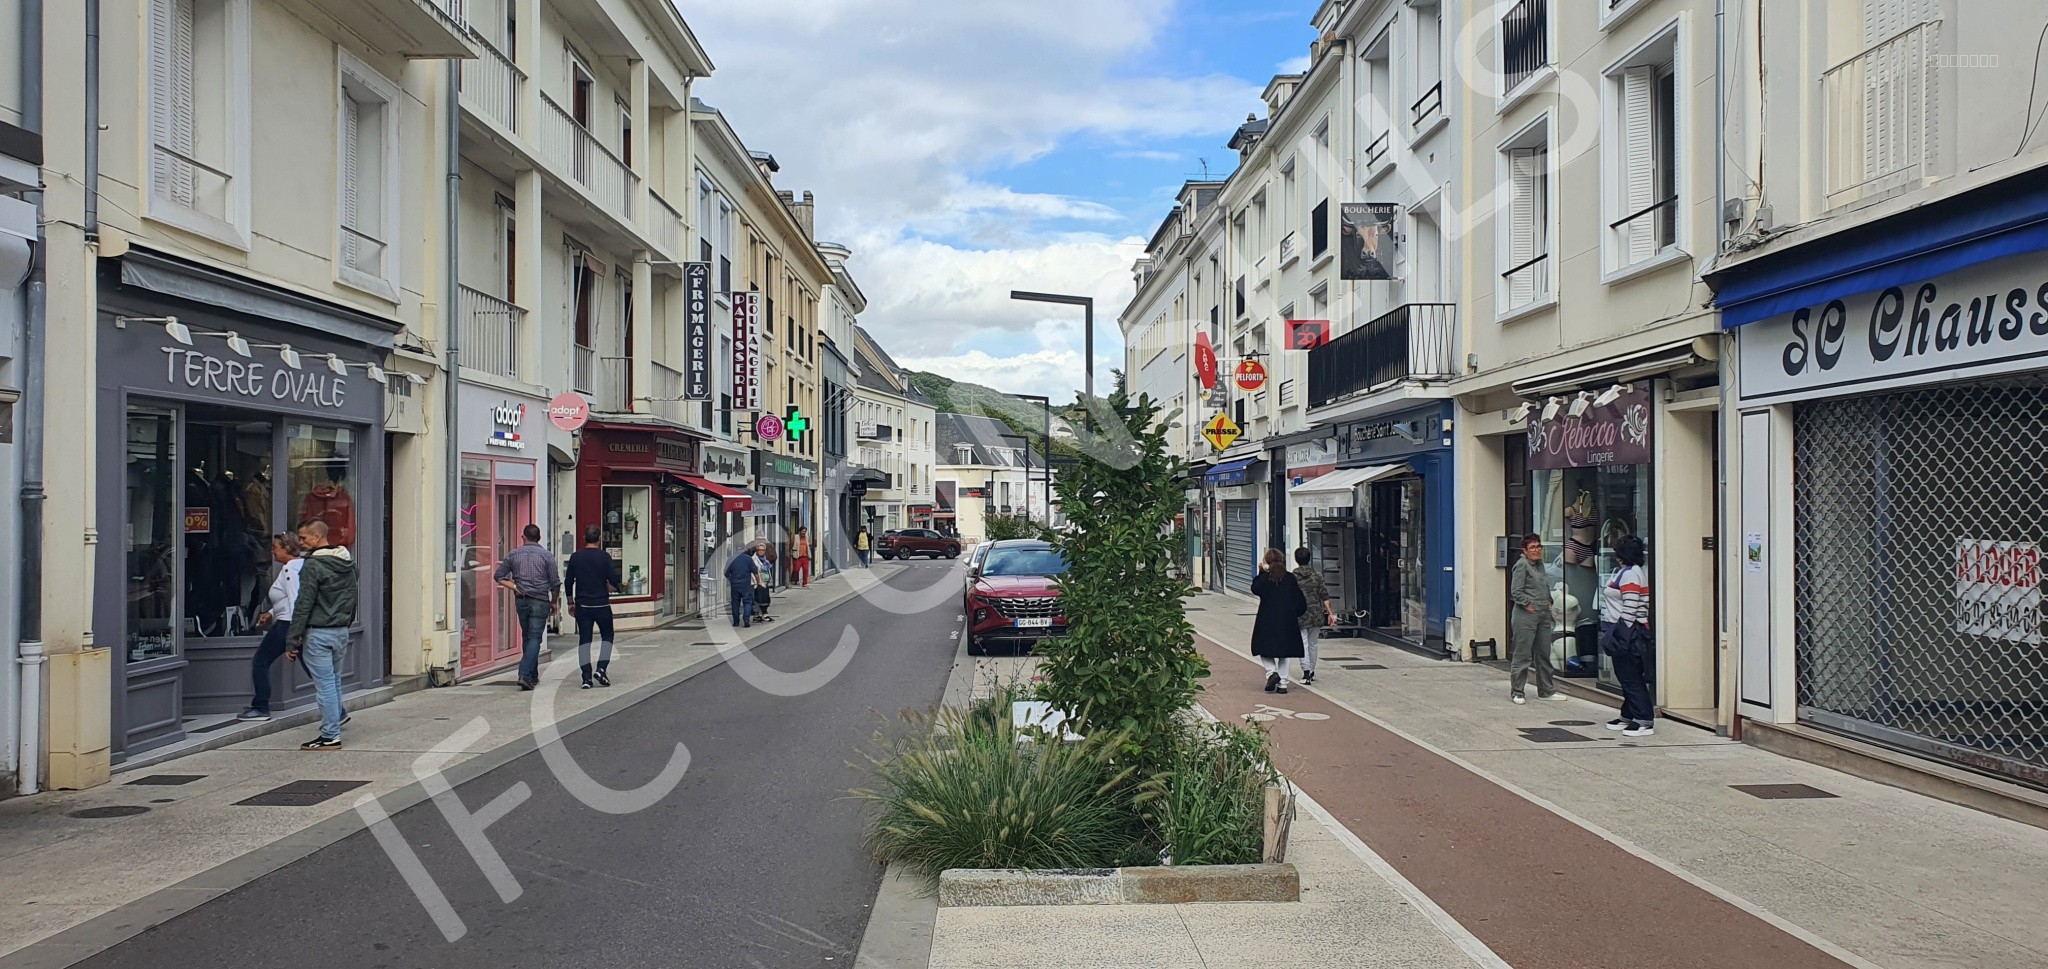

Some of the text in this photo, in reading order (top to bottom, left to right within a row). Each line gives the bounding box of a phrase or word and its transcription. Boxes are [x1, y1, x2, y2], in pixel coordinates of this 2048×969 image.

[1344, 206, 1391, 214] BOUCHERIE
[690, 266, 705, 276] La
[691, 277, 704, 395] FROMAGERIE
[734, 295, 745, 407] PATISSERIE
[748, 295, 759, 407] BOULANGERIE
[1296, 331, 1317, 349] 29
[1782, 299, 1846, 377] SC
[161, 347, 345, 408] TERRE OVALE
[1236, 373, 1264, 381] PELFORTH
[1548, 414, 1617, 467] Rebecca
[1587, 448, 1614, 465] Lingerie
[1958, 545, 2037, 587] A LOUER
